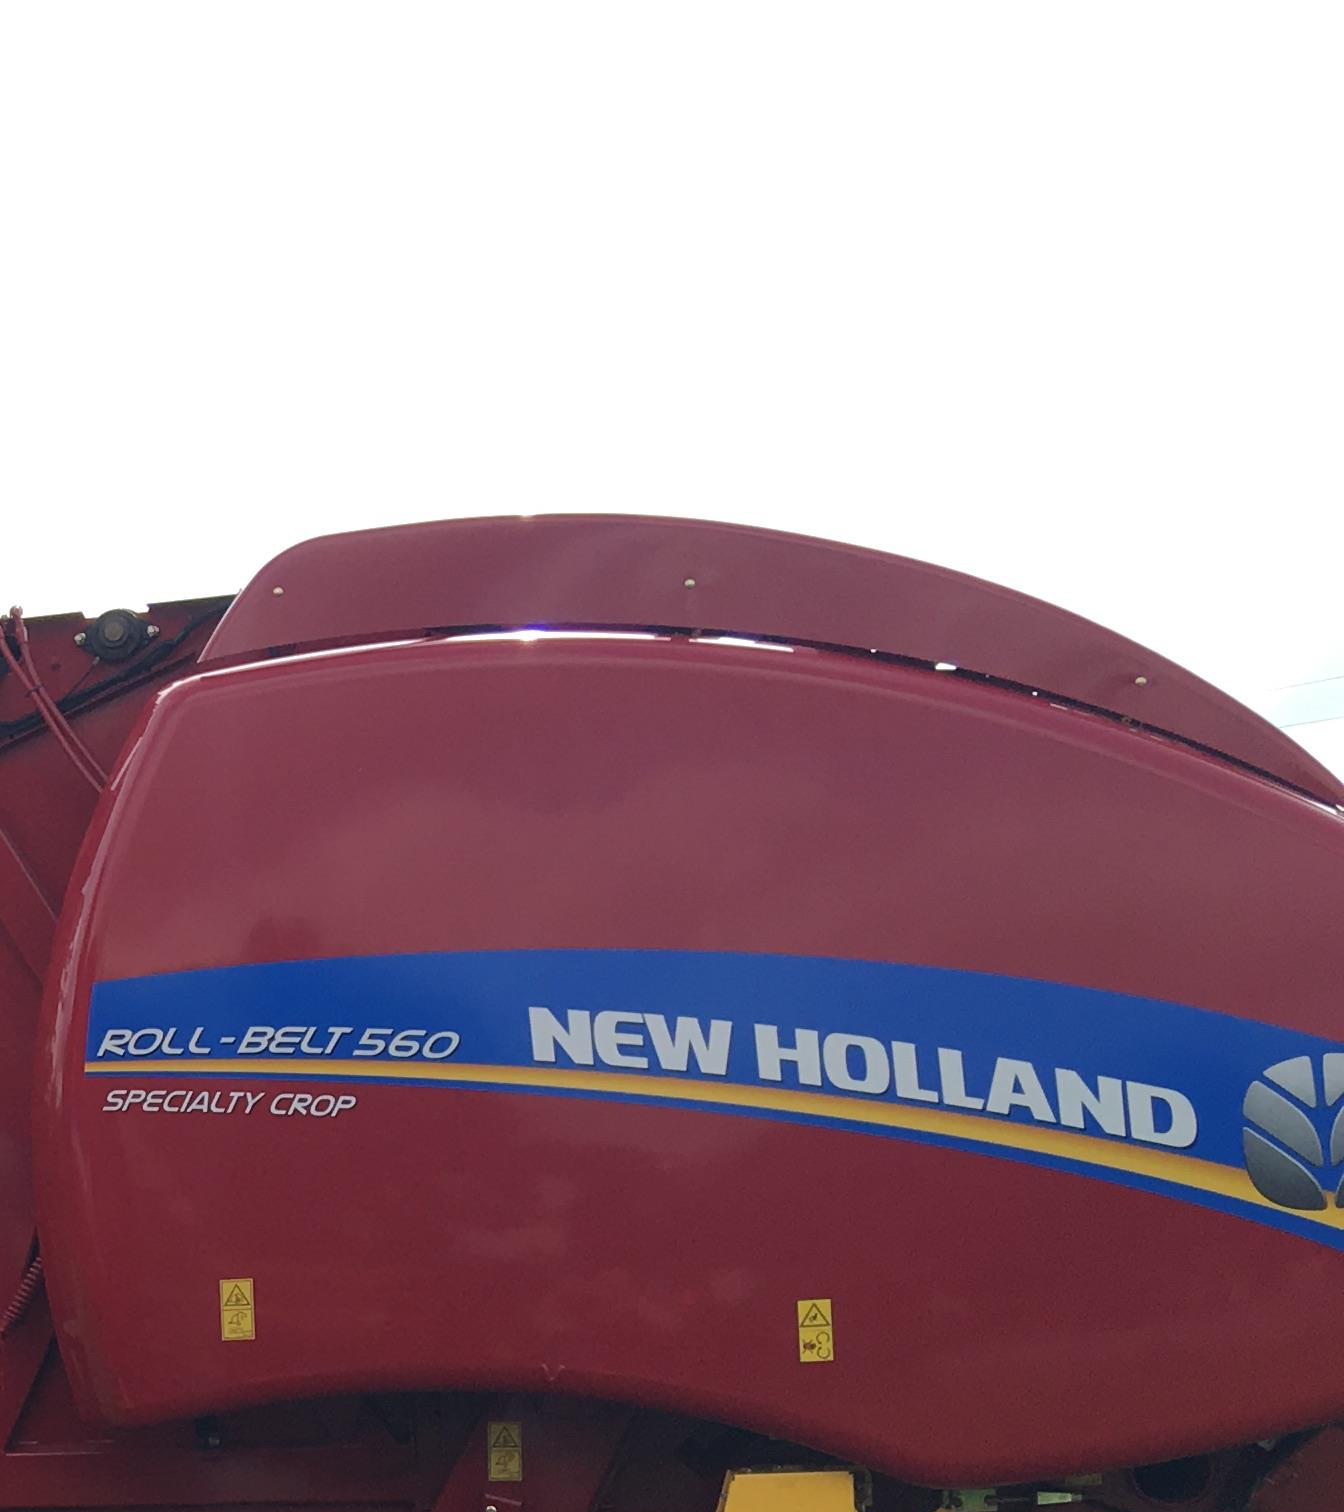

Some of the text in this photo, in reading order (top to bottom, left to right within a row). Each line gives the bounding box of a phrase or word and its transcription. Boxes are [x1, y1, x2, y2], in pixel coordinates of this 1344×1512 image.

[354, 1029, 461, 1060] 560
[527, 1006, 1198, 1150] NEW HOLLAND
[102, 1089, 357, 1118] SPECIALTY CROP
